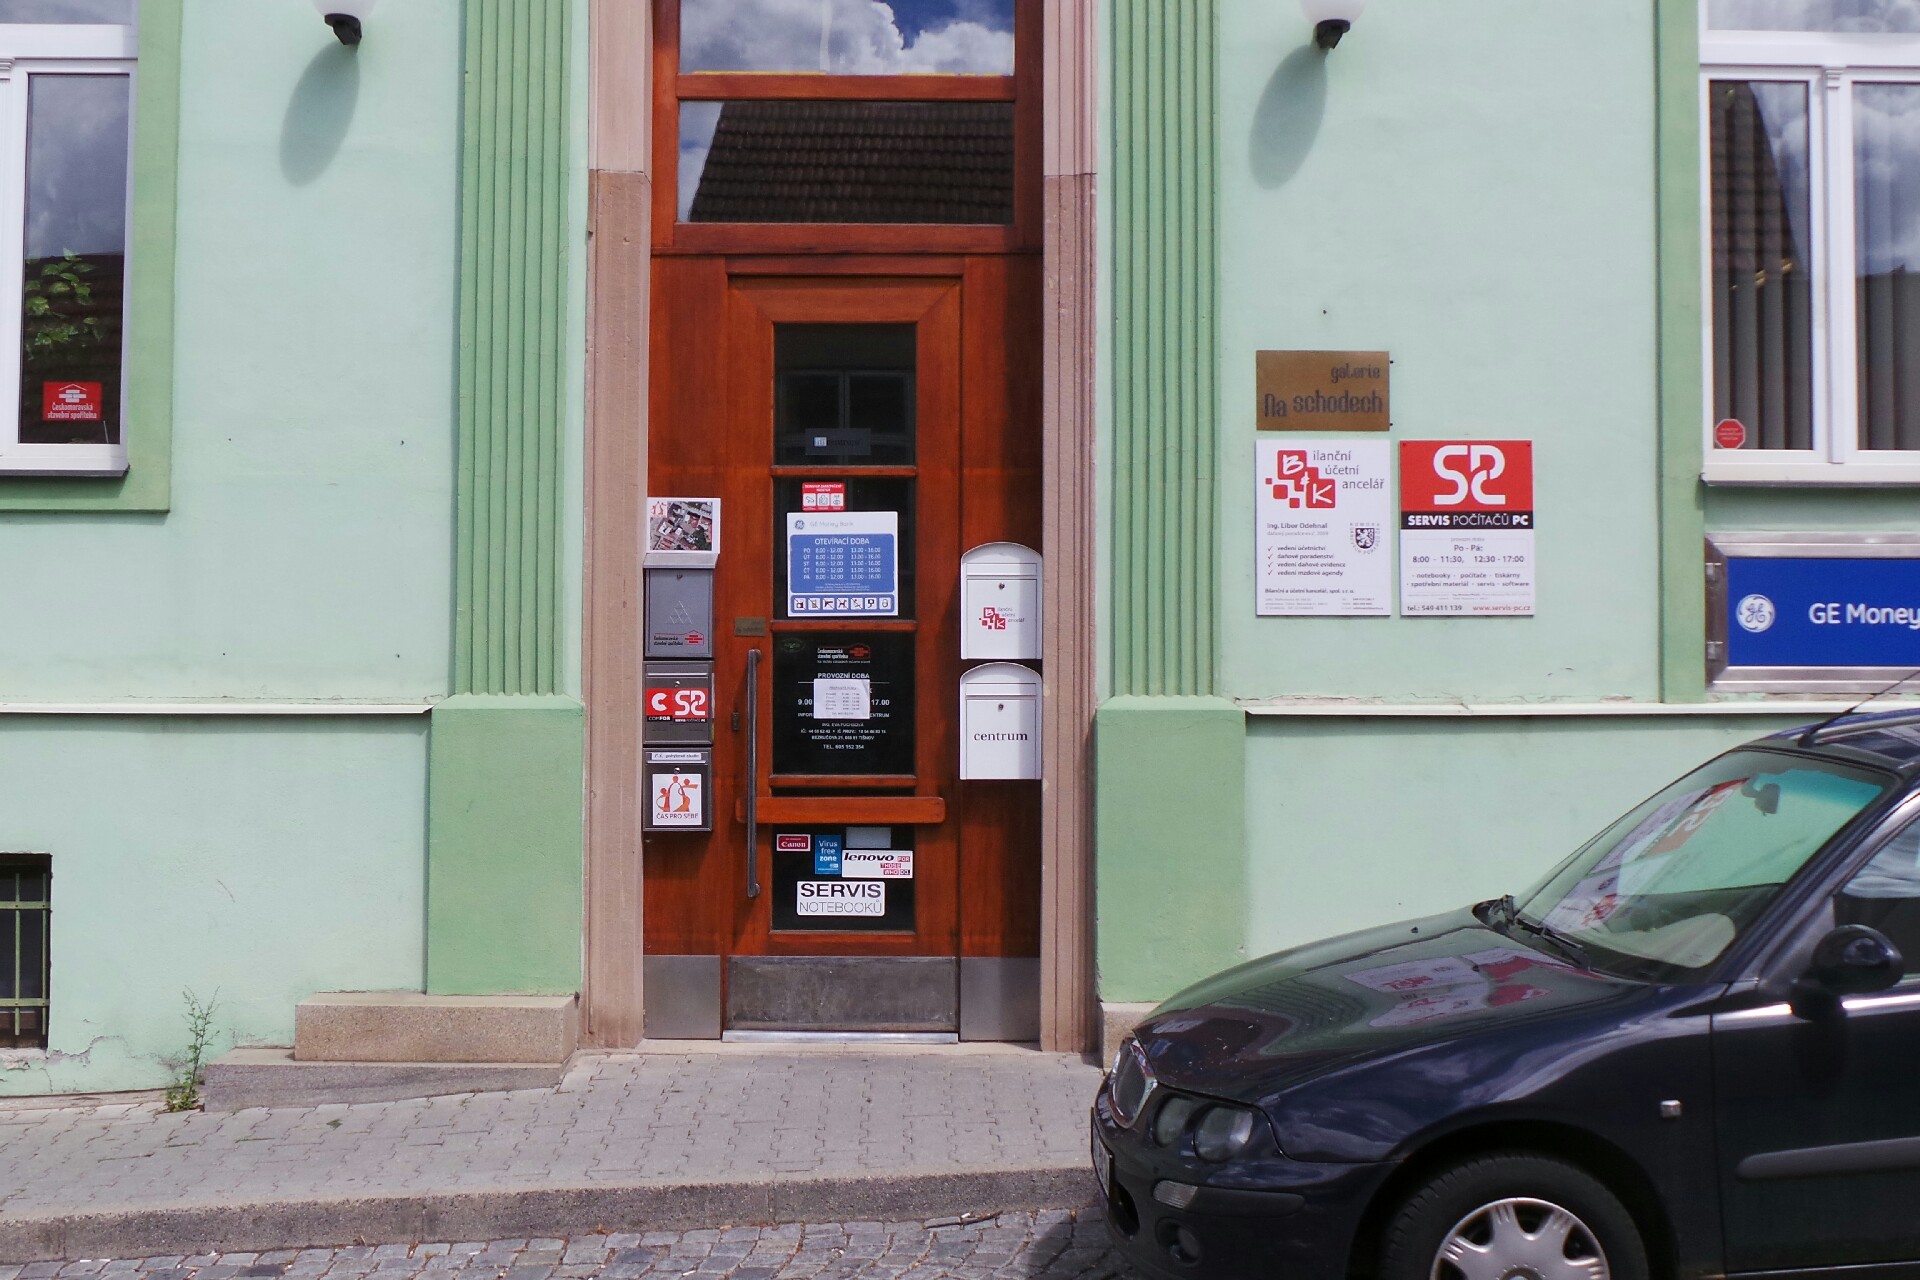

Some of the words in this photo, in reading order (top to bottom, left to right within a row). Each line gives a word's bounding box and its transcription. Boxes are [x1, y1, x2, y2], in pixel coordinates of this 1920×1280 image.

[1264, 393, 1287, 417] Na
[1293, 390, 1383, 413] schodech
[1313, 450, 1351, 461] ilanční
[1325, 465, 1359, 475] účetní
[1342, 478, 1384, 489] ancelář
[1408, 515, 1450, 526] SERVIS
[1453, 513, 1508, 526] POČÍTAČŮ
[1512, 515, 1528, 526] PC
[814, 537, 848, 545] OTEVÍRACÍ
[1808, 603, 1840, 624] GE
[1846, 603, 1920, 630] Money
[974, 732, 1028, 741] centrum
[844, 852, 894, 861] lenovo
[800, 883, 881, 898] SERVIS
[800, 899, 882, 913] NOTEBOOKŮ
